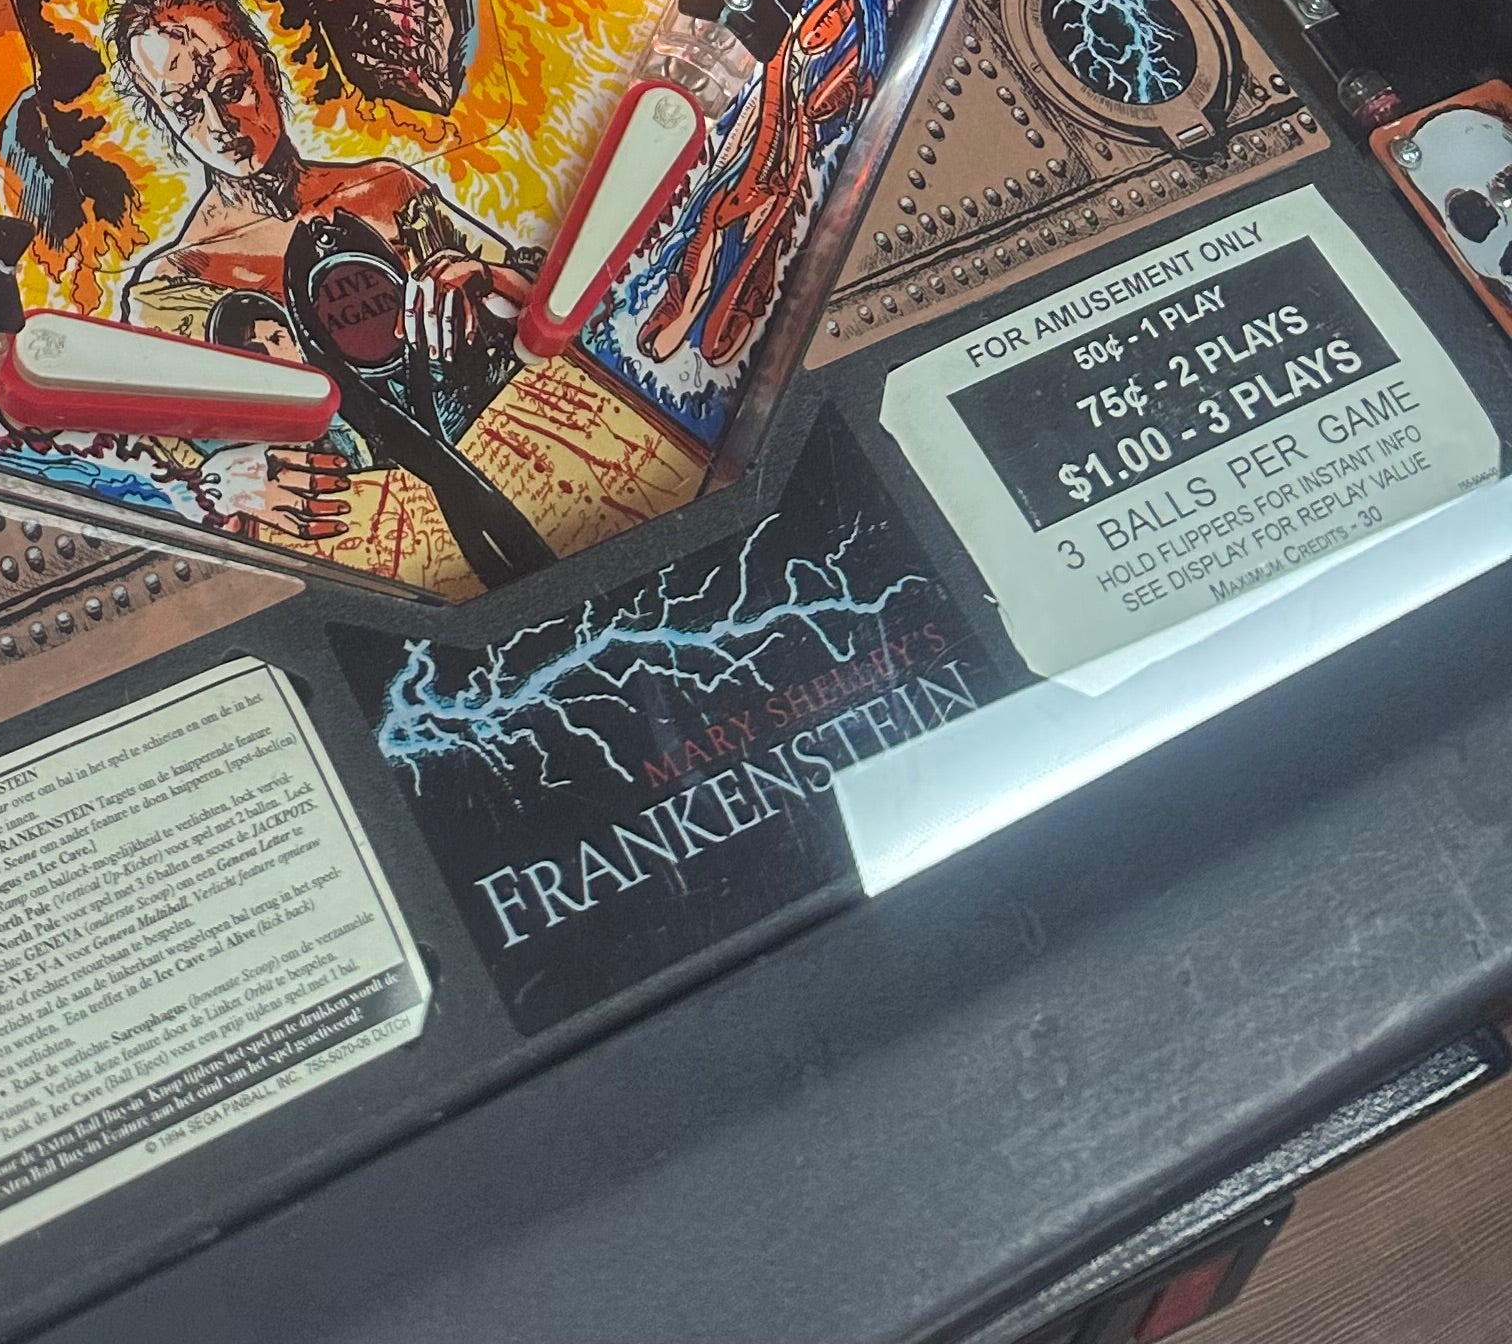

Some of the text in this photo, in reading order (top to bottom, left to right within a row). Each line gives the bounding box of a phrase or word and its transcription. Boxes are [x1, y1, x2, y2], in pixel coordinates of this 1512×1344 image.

[319, 270, 378, 305] LIVE
[326, 288, 403, 335] AGAIN
[965, 221, 1264, 368] FOR AMUSEMENT ONLY
[1072, 334, 1124, 371] 50¢
[1141, 317, 1159, 339] 1
[1159, 285, 1226, 331] PLAY
[1057, 426, 1172, 502] $1.00
[1199, 400, 1230, 434] 3
[1229, 339, 1362, 420] PLAYS
[1076, 378, 1147, 428] 75¢
[1169, 355, 1198, 387] 2
[1195, 305, 1308, 374] PLAYS
[1057, 381, 1420, 570] 3 BALLS PER GAME
[1097, 424, 1422, 591] HOLD FLIPPERS FOR INSTANT INFO
[1121, 582, 1168, 613] SEE
[1172, 537, 1254, 590] DISPLAY
[1253, 516, 1298, 549] FOR
[1300, 480, 1370, 526] REPLAY
[1369, 450, 1431, 491] VALUE
[1357, 506, 1383, 527] 30
[10, 791, 36, 808] over
[36, 782, 56, 797] om
[55, 771, 75, 788] bal
[74, 766, 89, 780] in
[86, 758, 107, 775] het
[105, 748, 131, 769] spel
[128, 744, 142, 757] te
[139, 724, 185, 752] schieten
[184, 720, 200, 732] en
[199, 712, 219, 726] om
[217, 703, 233, 718] de
[232, 698, 246, 712] in
[243, 691, 263, 706] het
[641, 623, 950, 789] MARY SHELLEY'S
[23, 868, 38, 881] en
[37, 856, 58, 874] Ice
[57, 838, 98, 866] Cave.]
[474, 660, 982, 949] FRANKENSTEIN
[157, 1124, 186, 1147] 1994
[185, 1106, 223, 1133] SEGA
[275, 1067, 301, 1088] INC.
[304, 1032, 371, 1074] 755-5070-06
[370, 1013, 411, 1041] DUTCH
